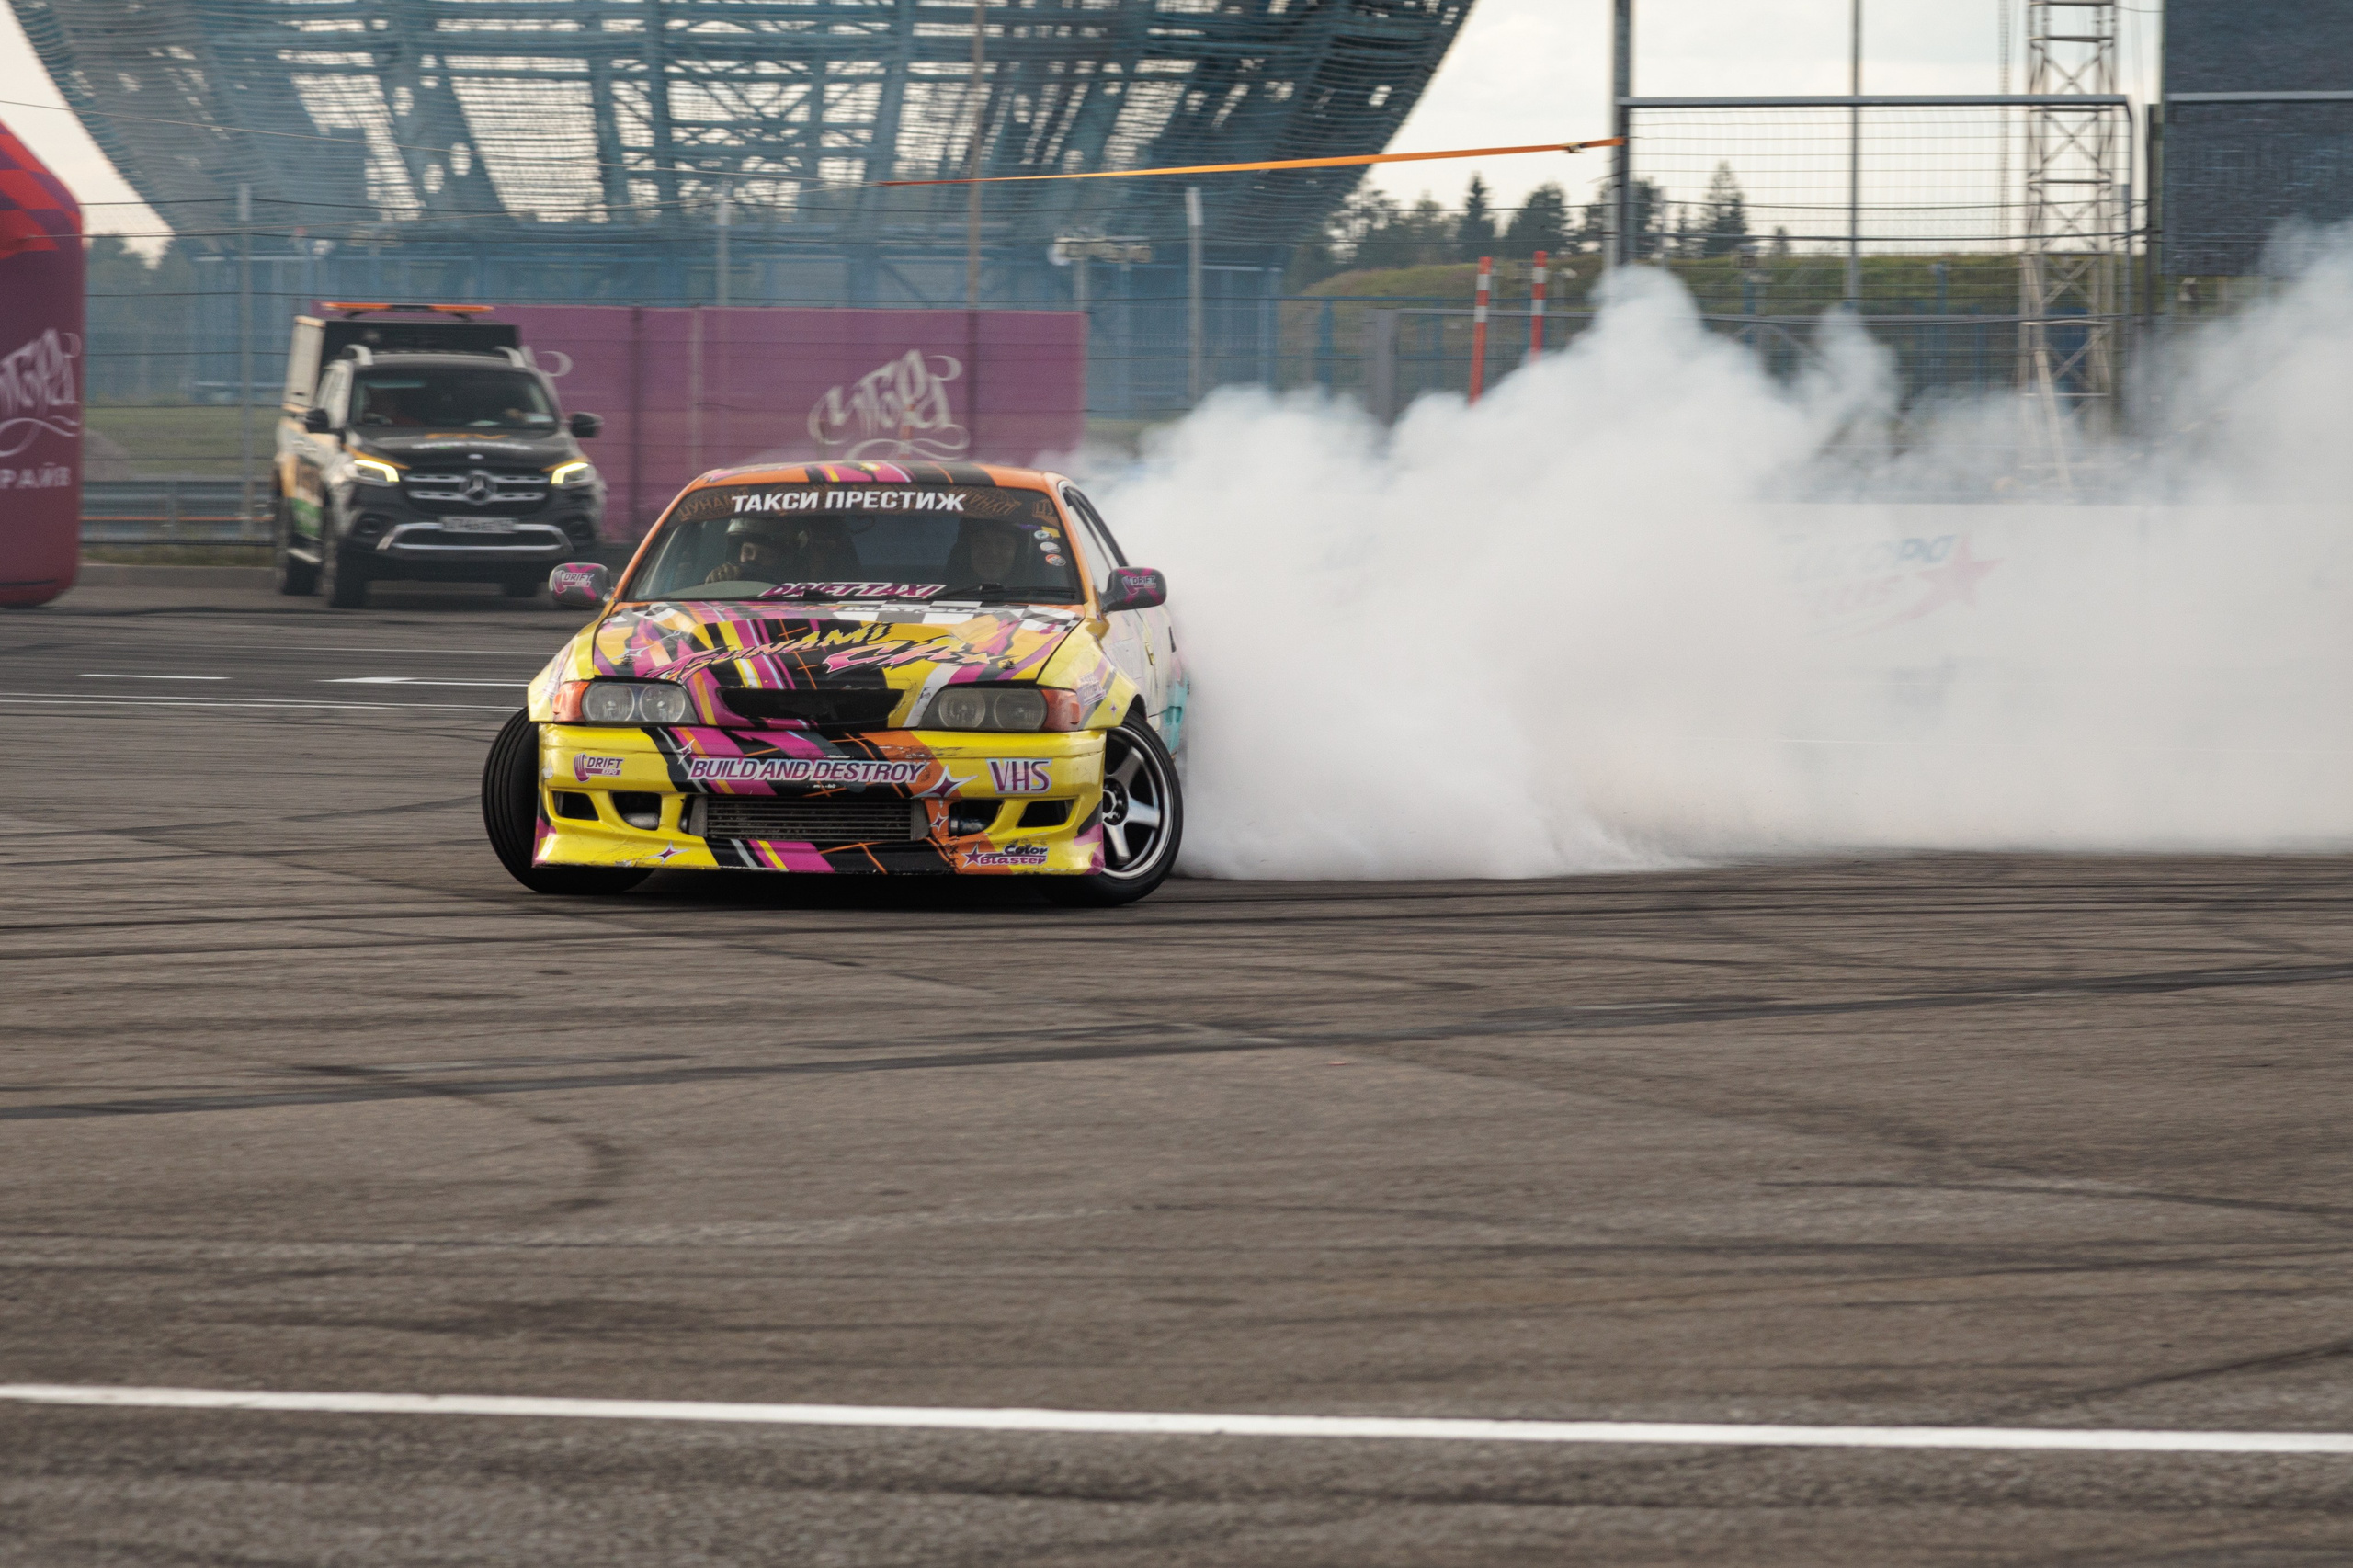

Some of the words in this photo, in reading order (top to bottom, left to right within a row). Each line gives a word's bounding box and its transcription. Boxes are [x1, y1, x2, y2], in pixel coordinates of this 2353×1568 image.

[733, 492, 818, 512] ТАКСИ
[825, 491, 966, 511] ПРЕСТИЖ
[563, 573, 594, 582] DRIFT
[858, 583, 947, 597] TAXI
[586, 757, 623, 768] DRIFT
[689, 760, 756, 779] BUILD
[759, 761, 810, 779] AND
[813, 761, 926, 781] DESTROY
[988, 759, 1051, 792] VHS
[1004, 844, 1049, 855] Color
[980, 856, 1048, 865] Blaster
